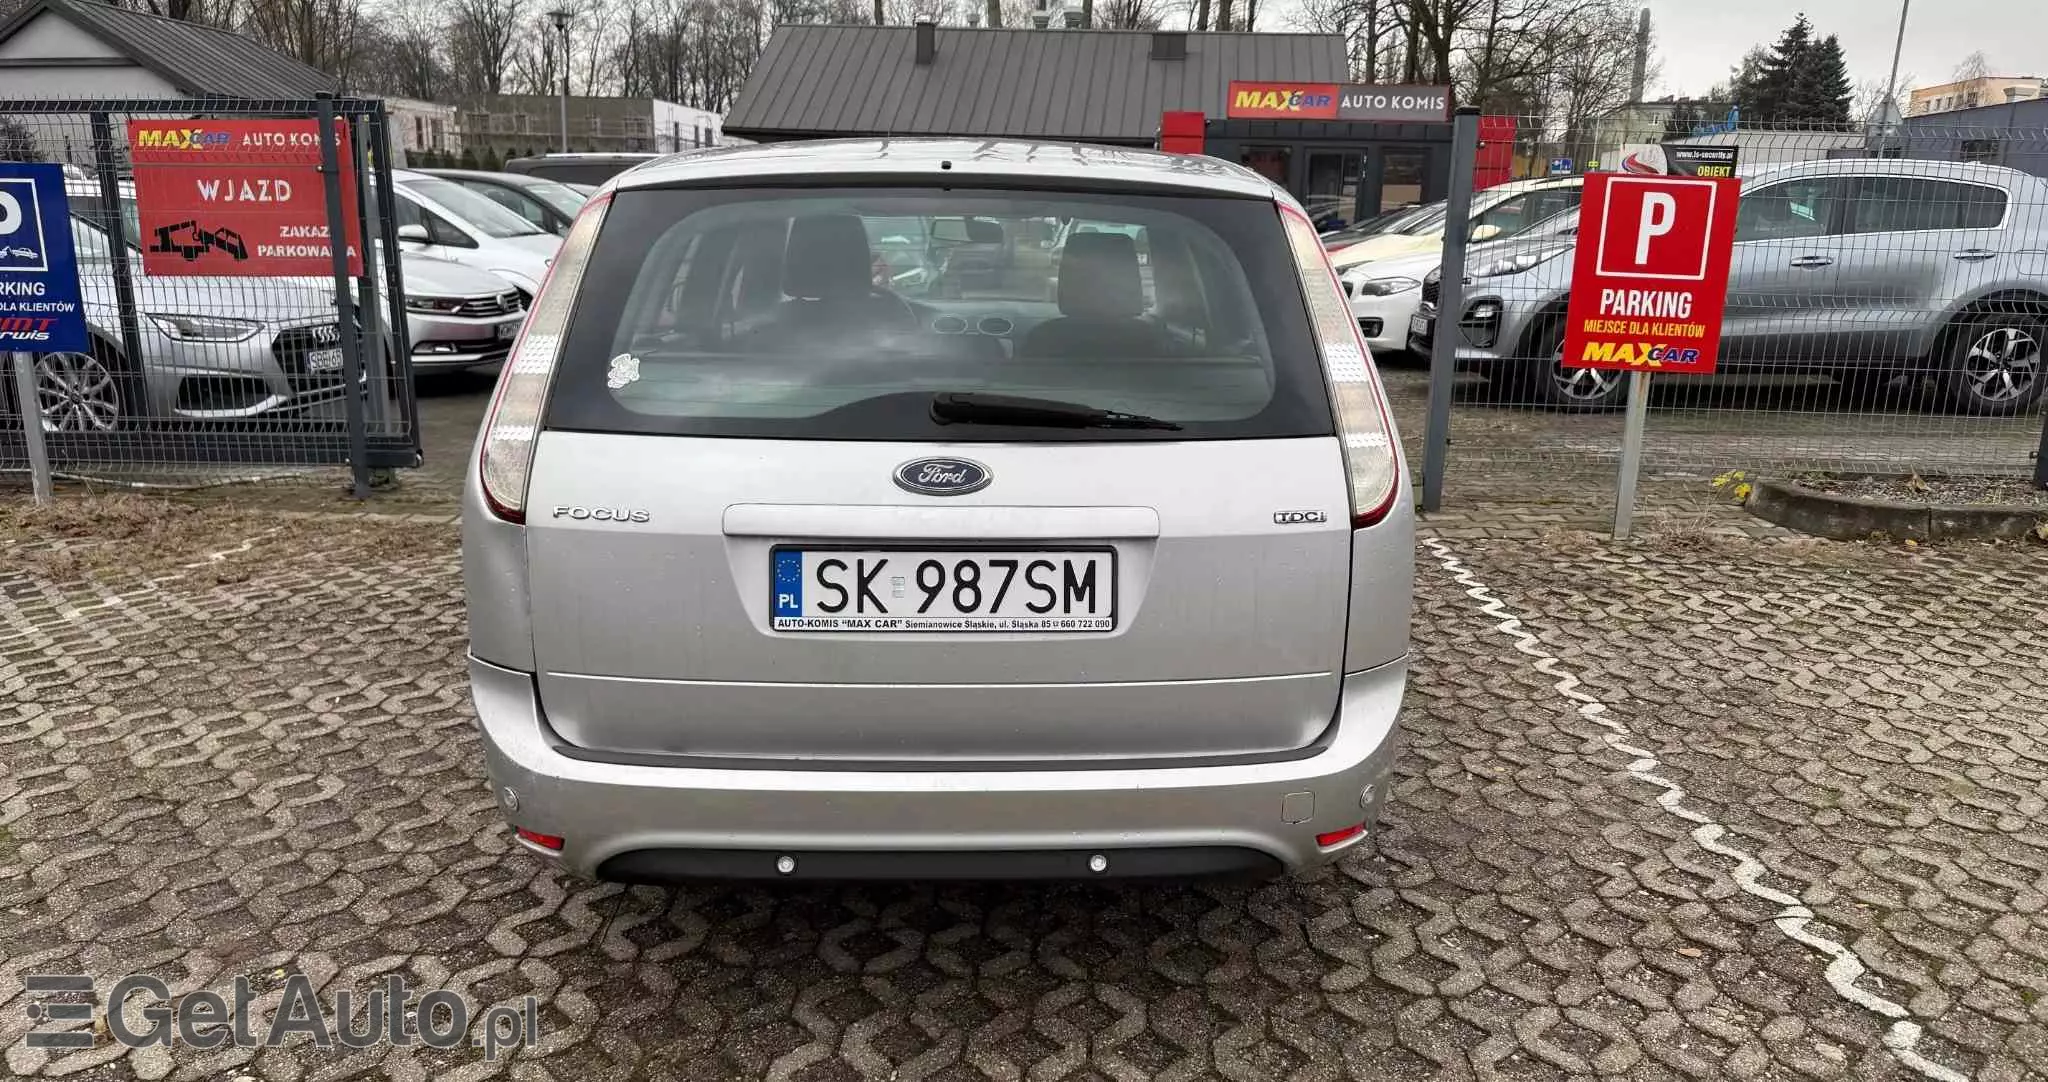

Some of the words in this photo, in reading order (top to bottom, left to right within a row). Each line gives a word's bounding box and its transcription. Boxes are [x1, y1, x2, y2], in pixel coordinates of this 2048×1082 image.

[1341, 95, 1386, 109] AUTO
[1391, 95, 1445, 110] KOMIS
[242, 132, 285, 147] AUTO
[1697, 165, 1732, 177] OBIEKT
[197, 179, 292, 202] WJAZD
[280, 226, 331, 238] ZAKAZ
[1634, 191, 1677, 265] P
[257, 244, 357, 257] PARKOWAA
[19, 300, 75, 312] KLIENTÓW
[1600, 288, 1693, 319] PARKING
[1583, 319, 1627, 334] MIEJSCE
[1629, 321, 1649, 335] DLA
[1651, 321, 1706, 338] KLIENTÓW
[918, 463, 968, 484] Ford
[553, 505, 650, 522] FOCUS
[816, 558, 889, 614] SK
[916, 559, 1096, 614] 987SM
[778, 593, 799, 609] PL
[777, 619, 839, 628] AUTO-KOMIS
[905, 619, 962, 629] Siemianowice
[1060, 619, 1076, 628] 660
[1078, 619, 1093, 628] 722
